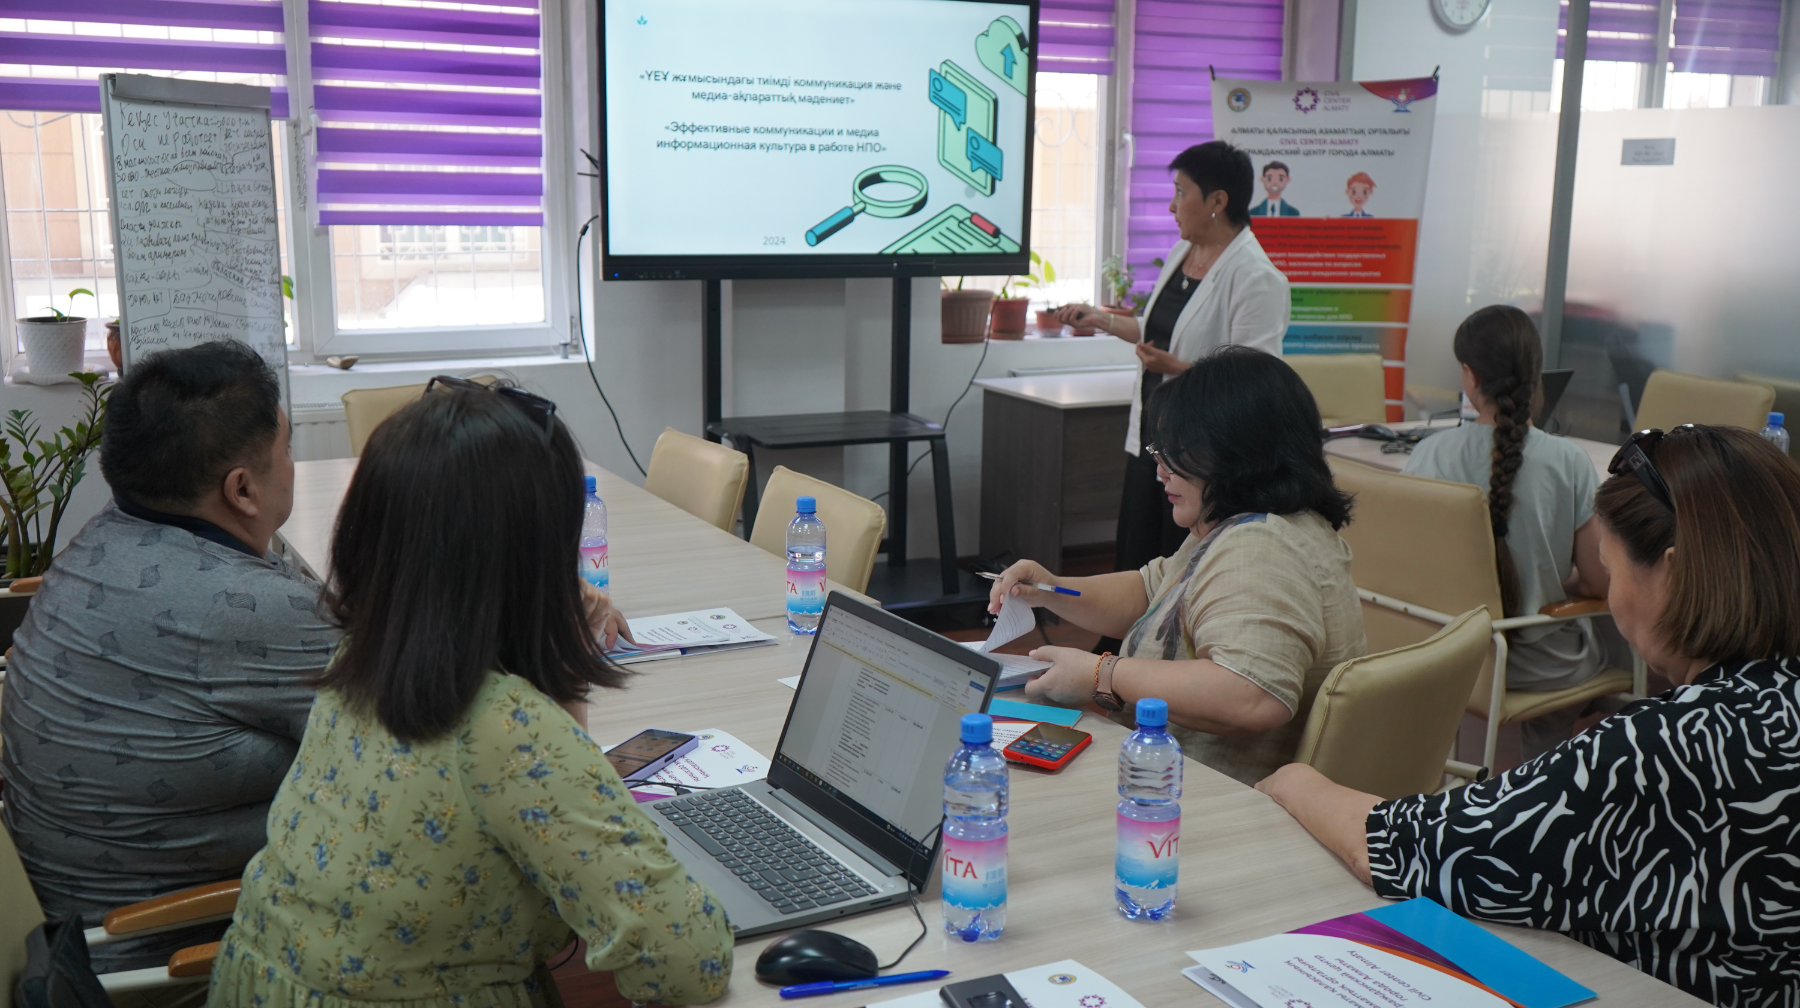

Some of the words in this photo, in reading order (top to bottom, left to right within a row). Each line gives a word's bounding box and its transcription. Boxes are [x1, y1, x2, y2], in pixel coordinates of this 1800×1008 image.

[757, 75, 791, 88] тиімді
[793, 79, 873, 90] коммуникация
[664, 121, 751, 135] «Эффективные
[753, 126, 834, 137] коммуникации
[837, 128, 843, 136] и
[846, 128, 879, 138] медиа
[1231, 127, 1264, 135] АЛМАТЫ
[656, 138, 757, 151] информационная
[759, 142, 807, 153] культура
[809, 143, 816, 151] в
[818, 141, 854, 154] работе
[1303, 149, 1327, 157] ЦЕНТР
[1329, 149, 1358, 157] ГОРОДА
[1360, 149, 1395, 157] АЛМАТЫ
[763, 236, 786, 245] 2024
[590, 552, 608, 569] VIT
[1146, 831, 1179, 858] VIT
[1314, 954, 1342, 972] центр
[1334, 957, 1373, 980] Алматы
[1347, 950, 1381, 971] Almaty
[1379, 970, 1411, 989] center
[1340, 971, 1408, 1008] ражданский
[1372, 980, 1408, 1002] города
[1407, 987, 1432, 1002] Civil
